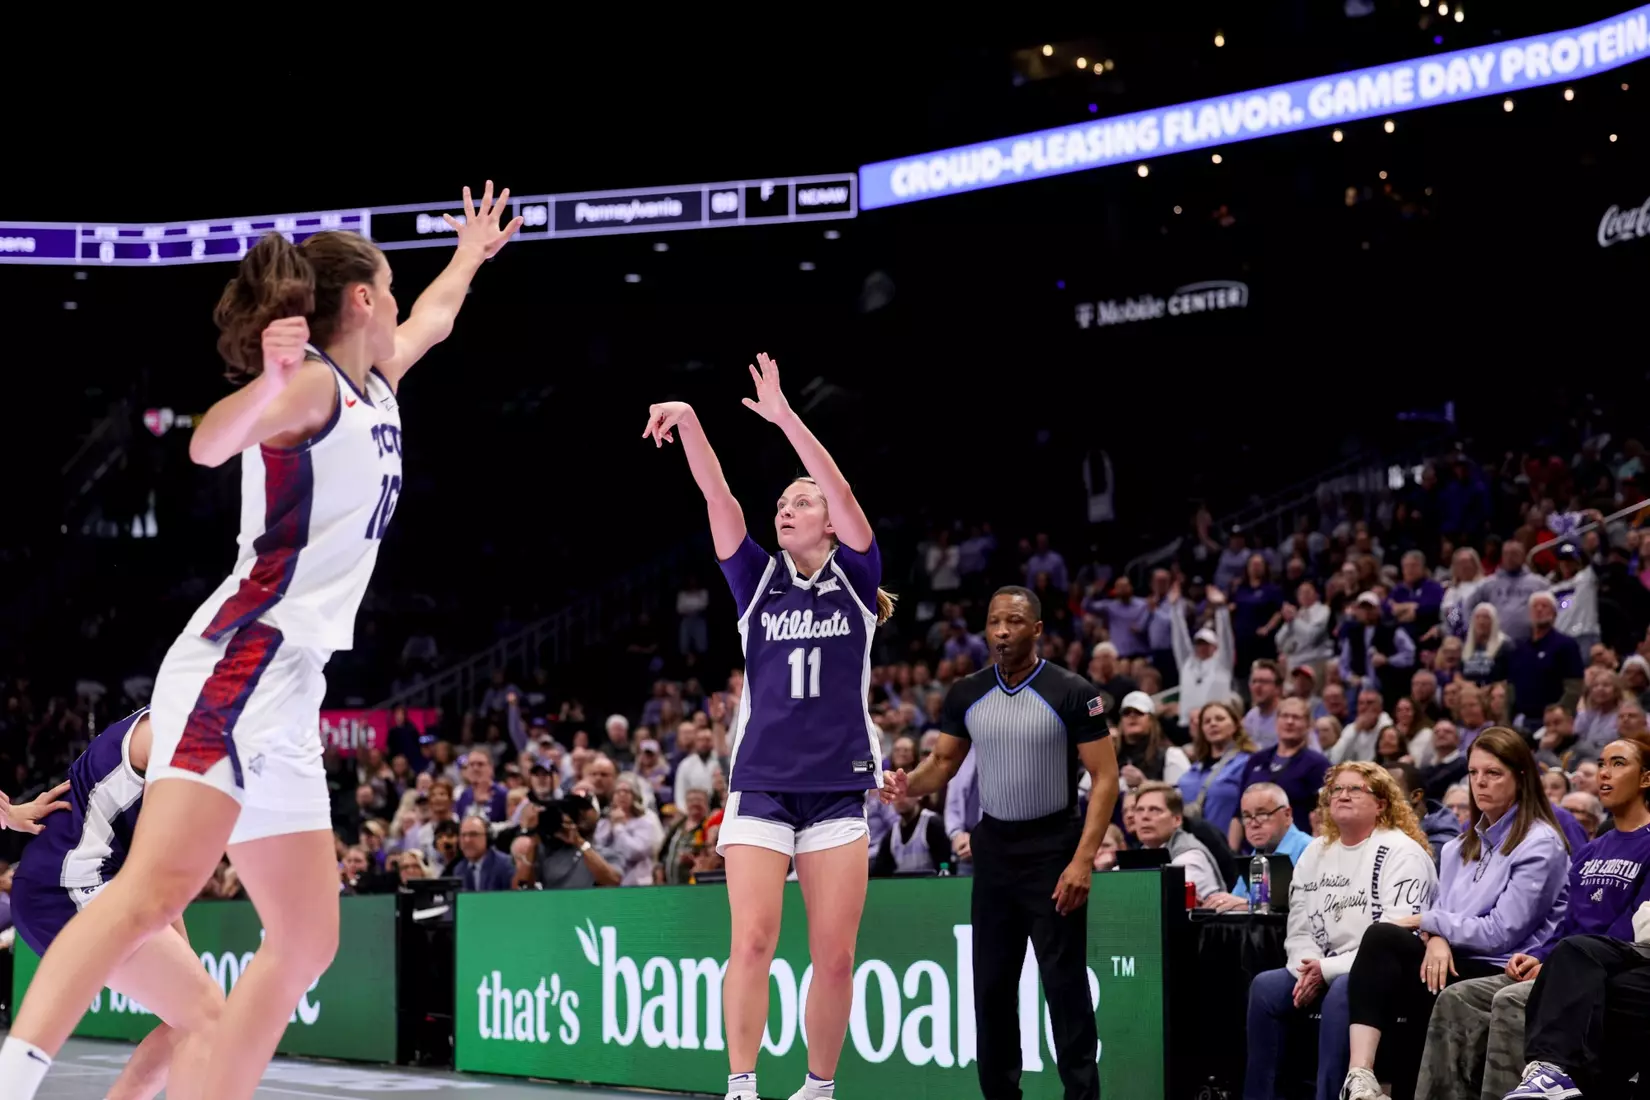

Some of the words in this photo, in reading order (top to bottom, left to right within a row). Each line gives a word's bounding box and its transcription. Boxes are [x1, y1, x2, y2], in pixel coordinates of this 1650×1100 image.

[889, 114, 1160, 198] CROWD-PLEASING
[1163, 89, 1304, 147] FLAVOR.
[1308, 67, 1414, 120] GAME
[1418, 52, 1496, 100] DAY
[1500, 15, 1650, 84] PROTEIN.
[575, 197, 683, 224] Pennsylvania
[761, 181, 775, 201] F
[1166, 285, 1241, 316] CENTER
[760, 608, 851, 642] Wildcats
[788, 646, 821, 699] 11
[1393, 878, 1430, 907] TCU
[476, 969, 580, 1046] that's
[1111, 955, 1136, 977] TM
